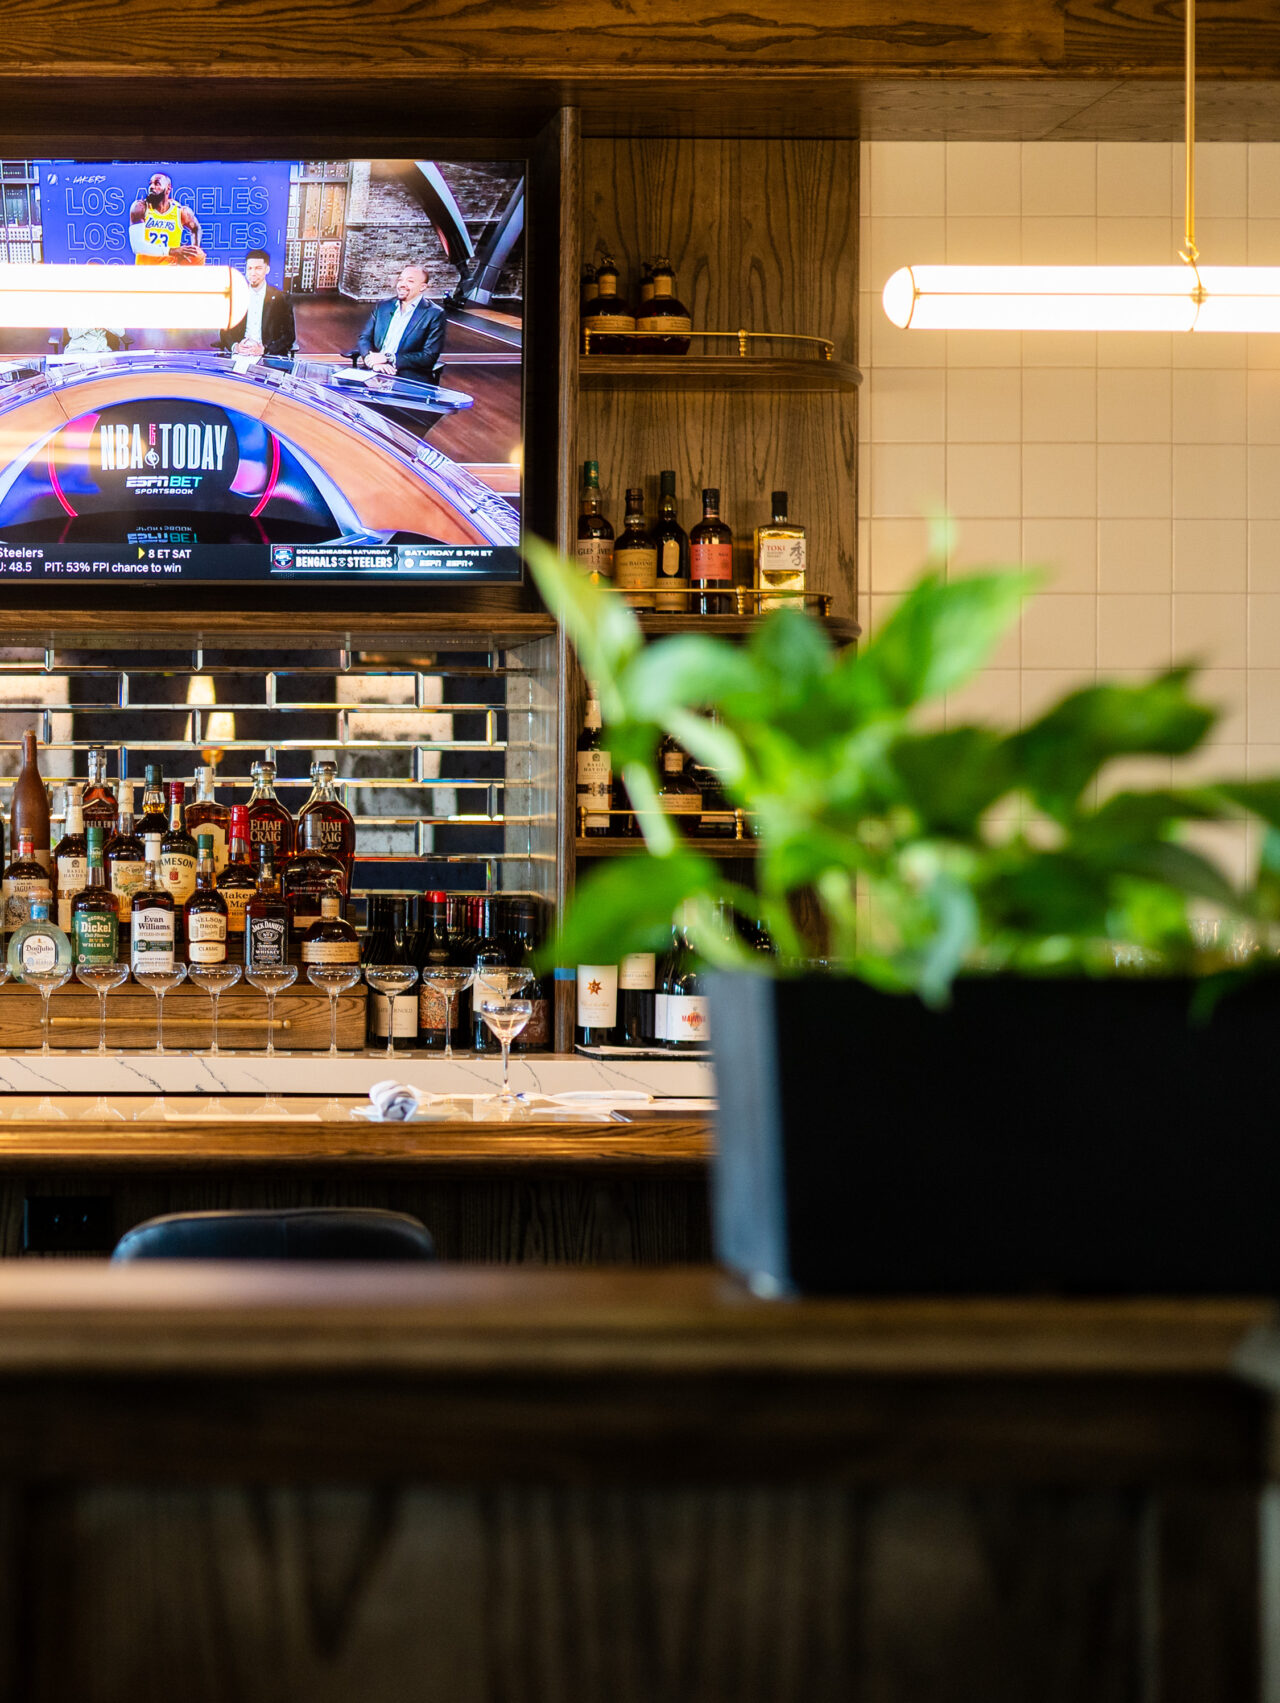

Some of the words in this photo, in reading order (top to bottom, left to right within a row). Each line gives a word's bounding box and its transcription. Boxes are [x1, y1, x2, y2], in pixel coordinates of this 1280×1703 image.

[73, 175, 106, 184] LAKERS
[66, 187, 124, 215] LOS
[135, 187, 269, 215] AGELES
[68, 222, 126, 250] LOS
[180, 222, 268, 250] GELES
[100, 424, 143, 471] NBA
[159, 423, 228, 470] TODAY
[148, 550, 155, 558] 8
[157, 550, 169, 558] ET
[172, 550, 191, 558] SAT
[8, 562, 32, 572] 48.5
[44, 562, 64, 572] PIT:
[66, 562, 91, 572] 53%
[92, 562, 109, 572] FPI
[111, 562, 148, 572] chance
[151, 563, 162, 572] to
[163, 563, 182, 572] win
[296, 556, 338, 568] BENGALS
[347, 556, 393, 568] STEELERS
[250, 820, 281, 831] ELIJAH
[321, 821, 342, 831] IJAH
[250, 830, 281, 842] CRAIG
[320, 831, 342, 842] RAIG
[160, 857, 193, 869] AMESON
[14, 885, 36, 893] JAGUA
[221, 890, 257, 899] Maker'
[230, 900, 247, 908] Ma
[195, 916, 223, 924] NELSON
[81, 921, 111, 932] Dickel
[138, 922, 170, 930] Williams
[252, 922, 265, 933] JACK
[264, 921, 284, 933] DANIEL'S
